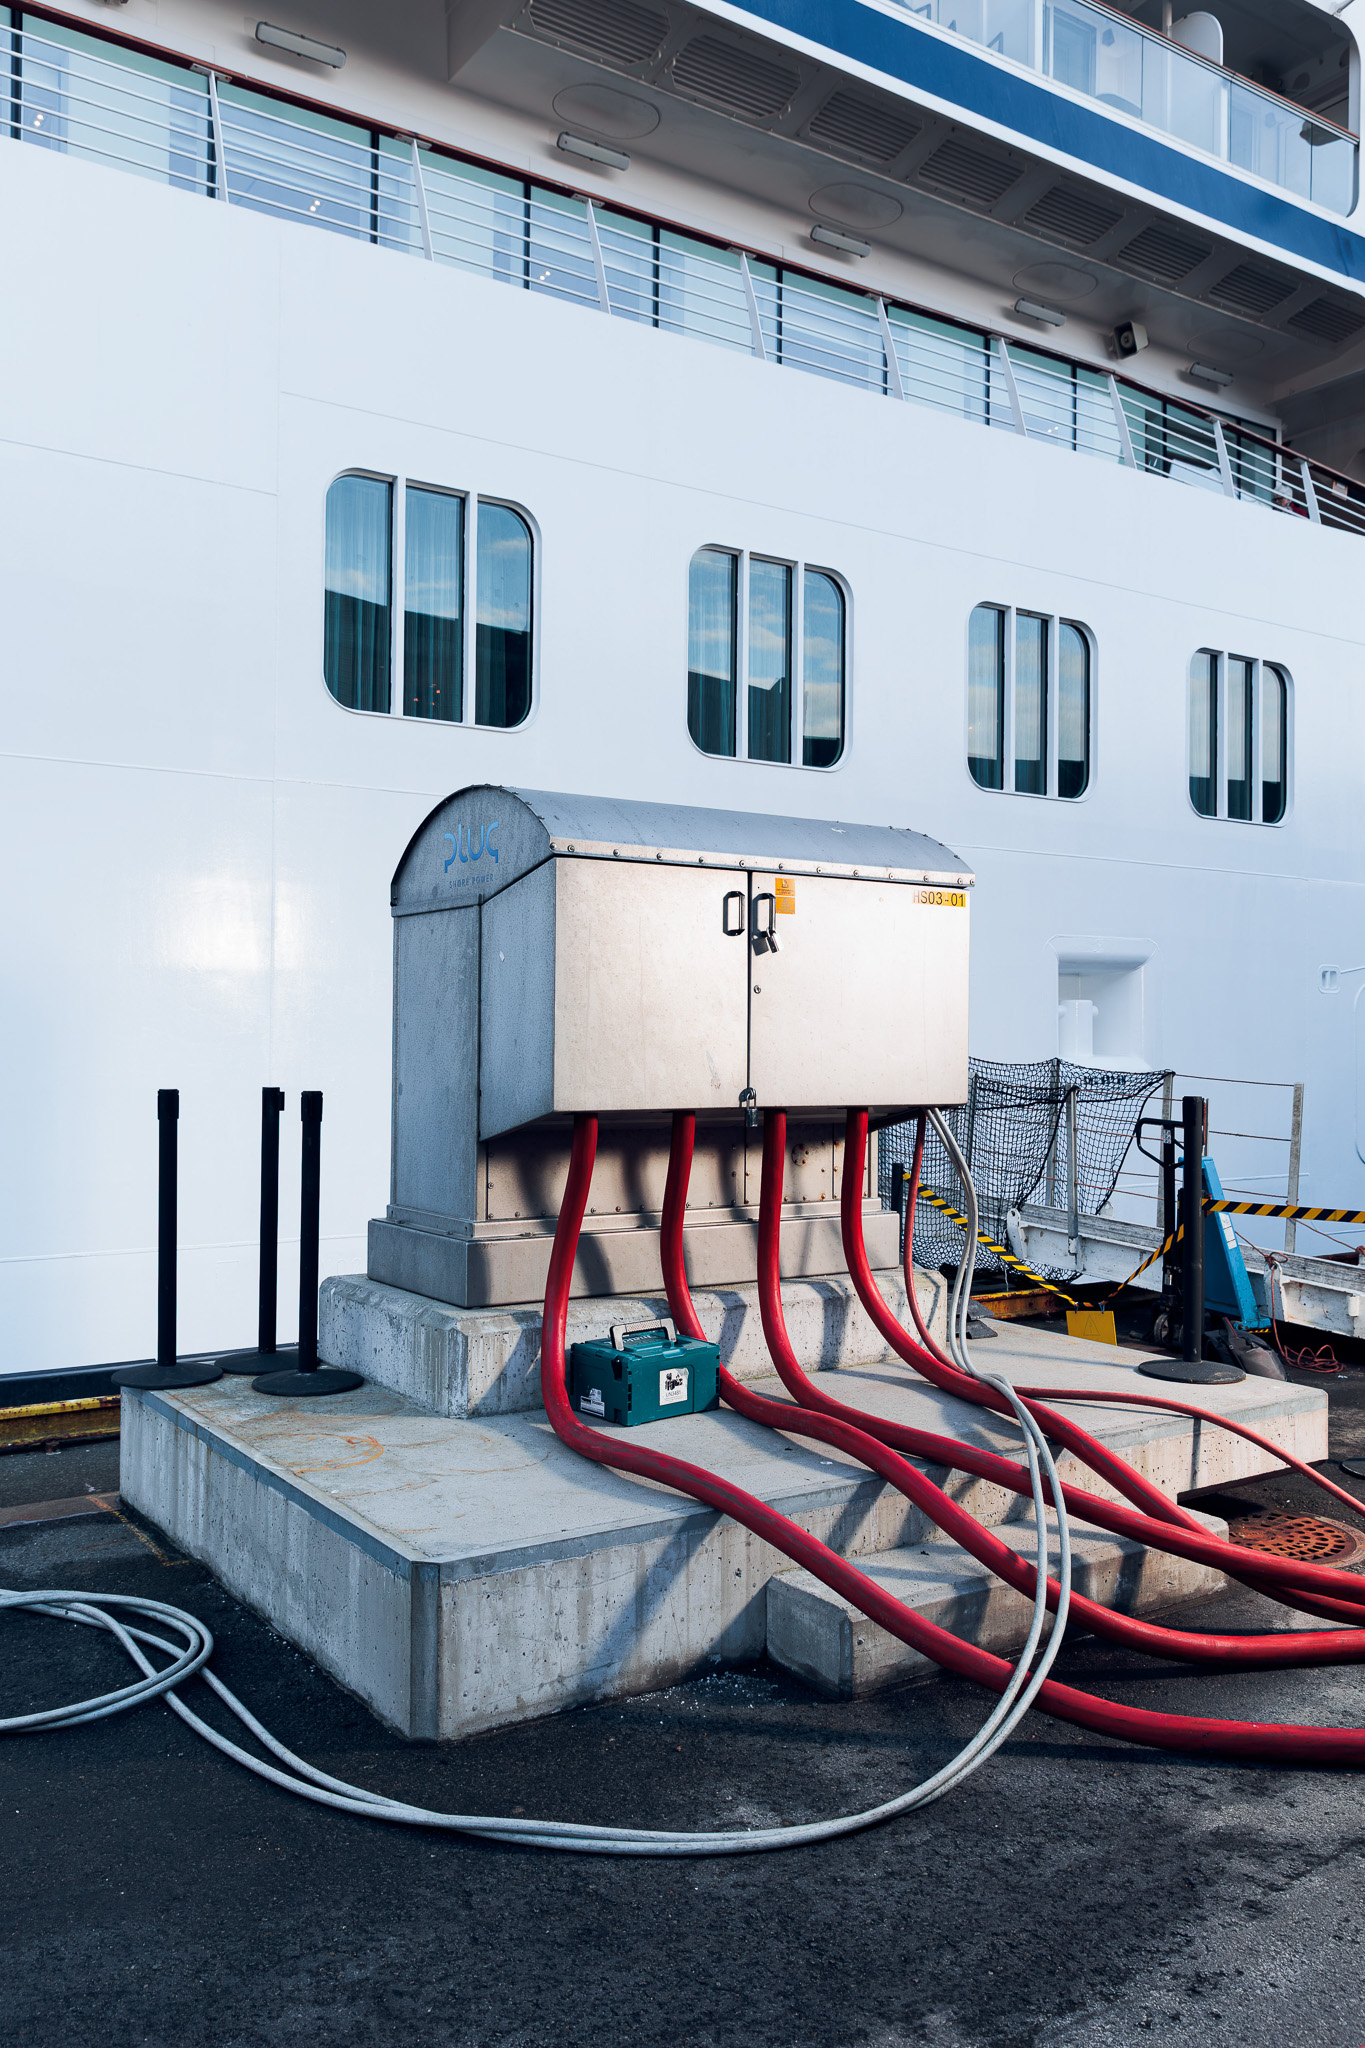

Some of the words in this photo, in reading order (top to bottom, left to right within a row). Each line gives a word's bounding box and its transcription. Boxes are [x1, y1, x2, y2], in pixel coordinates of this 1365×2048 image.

[449, 878, 469, 889] SHORE
[472, 873, 494, 885] POWER
[913, 890, 964, 906] HS03-01
